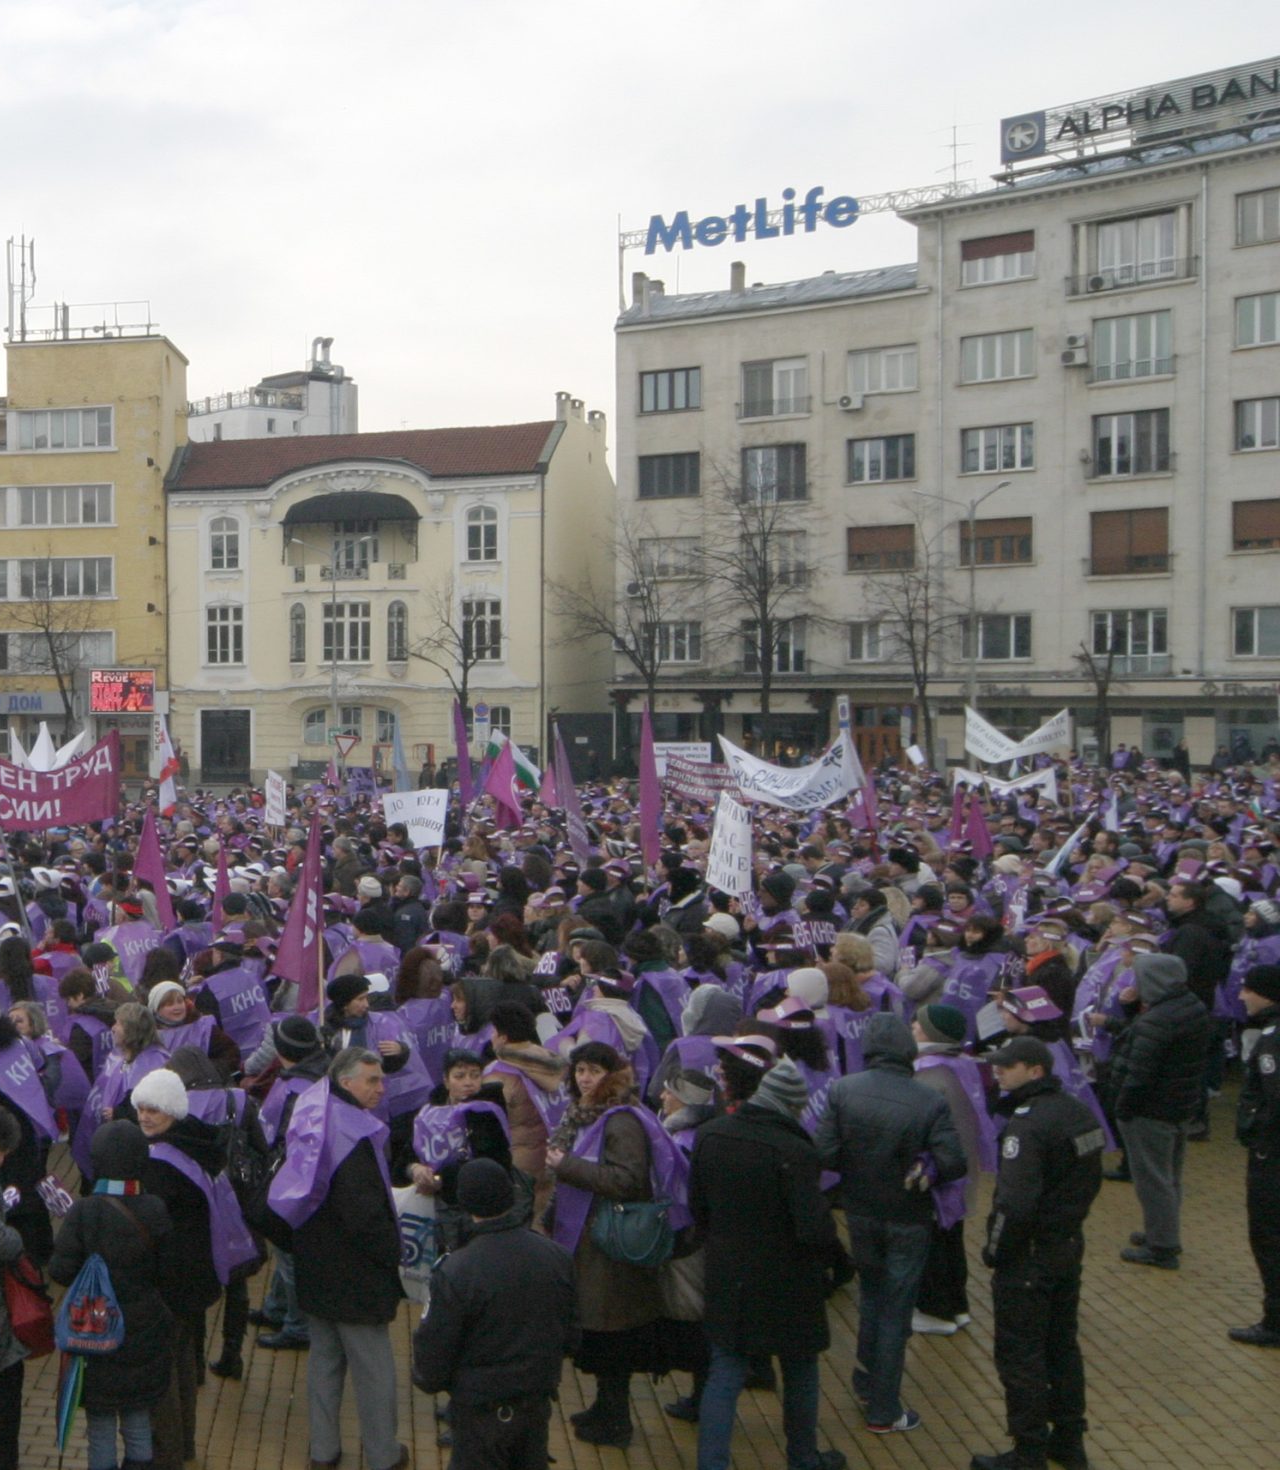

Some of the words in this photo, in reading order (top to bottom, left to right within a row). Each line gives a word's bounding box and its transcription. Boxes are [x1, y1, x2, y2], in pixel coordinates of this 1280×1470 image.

[1056, 93, 1181, 140] ALPHA
[1191, 69, 1280, 111] BAN
[645, 186, 859, 255] MetLife
[8, 695, 42, 713] ДОМ
[46, 745, 112, 791] ТРУД
[229, 985, 265, 1013] КНС
[944, 979, 972, 1000] СБ
[5, 1054, 36, 1086] КН
[420, 1128, 467, 1162] НСБ
